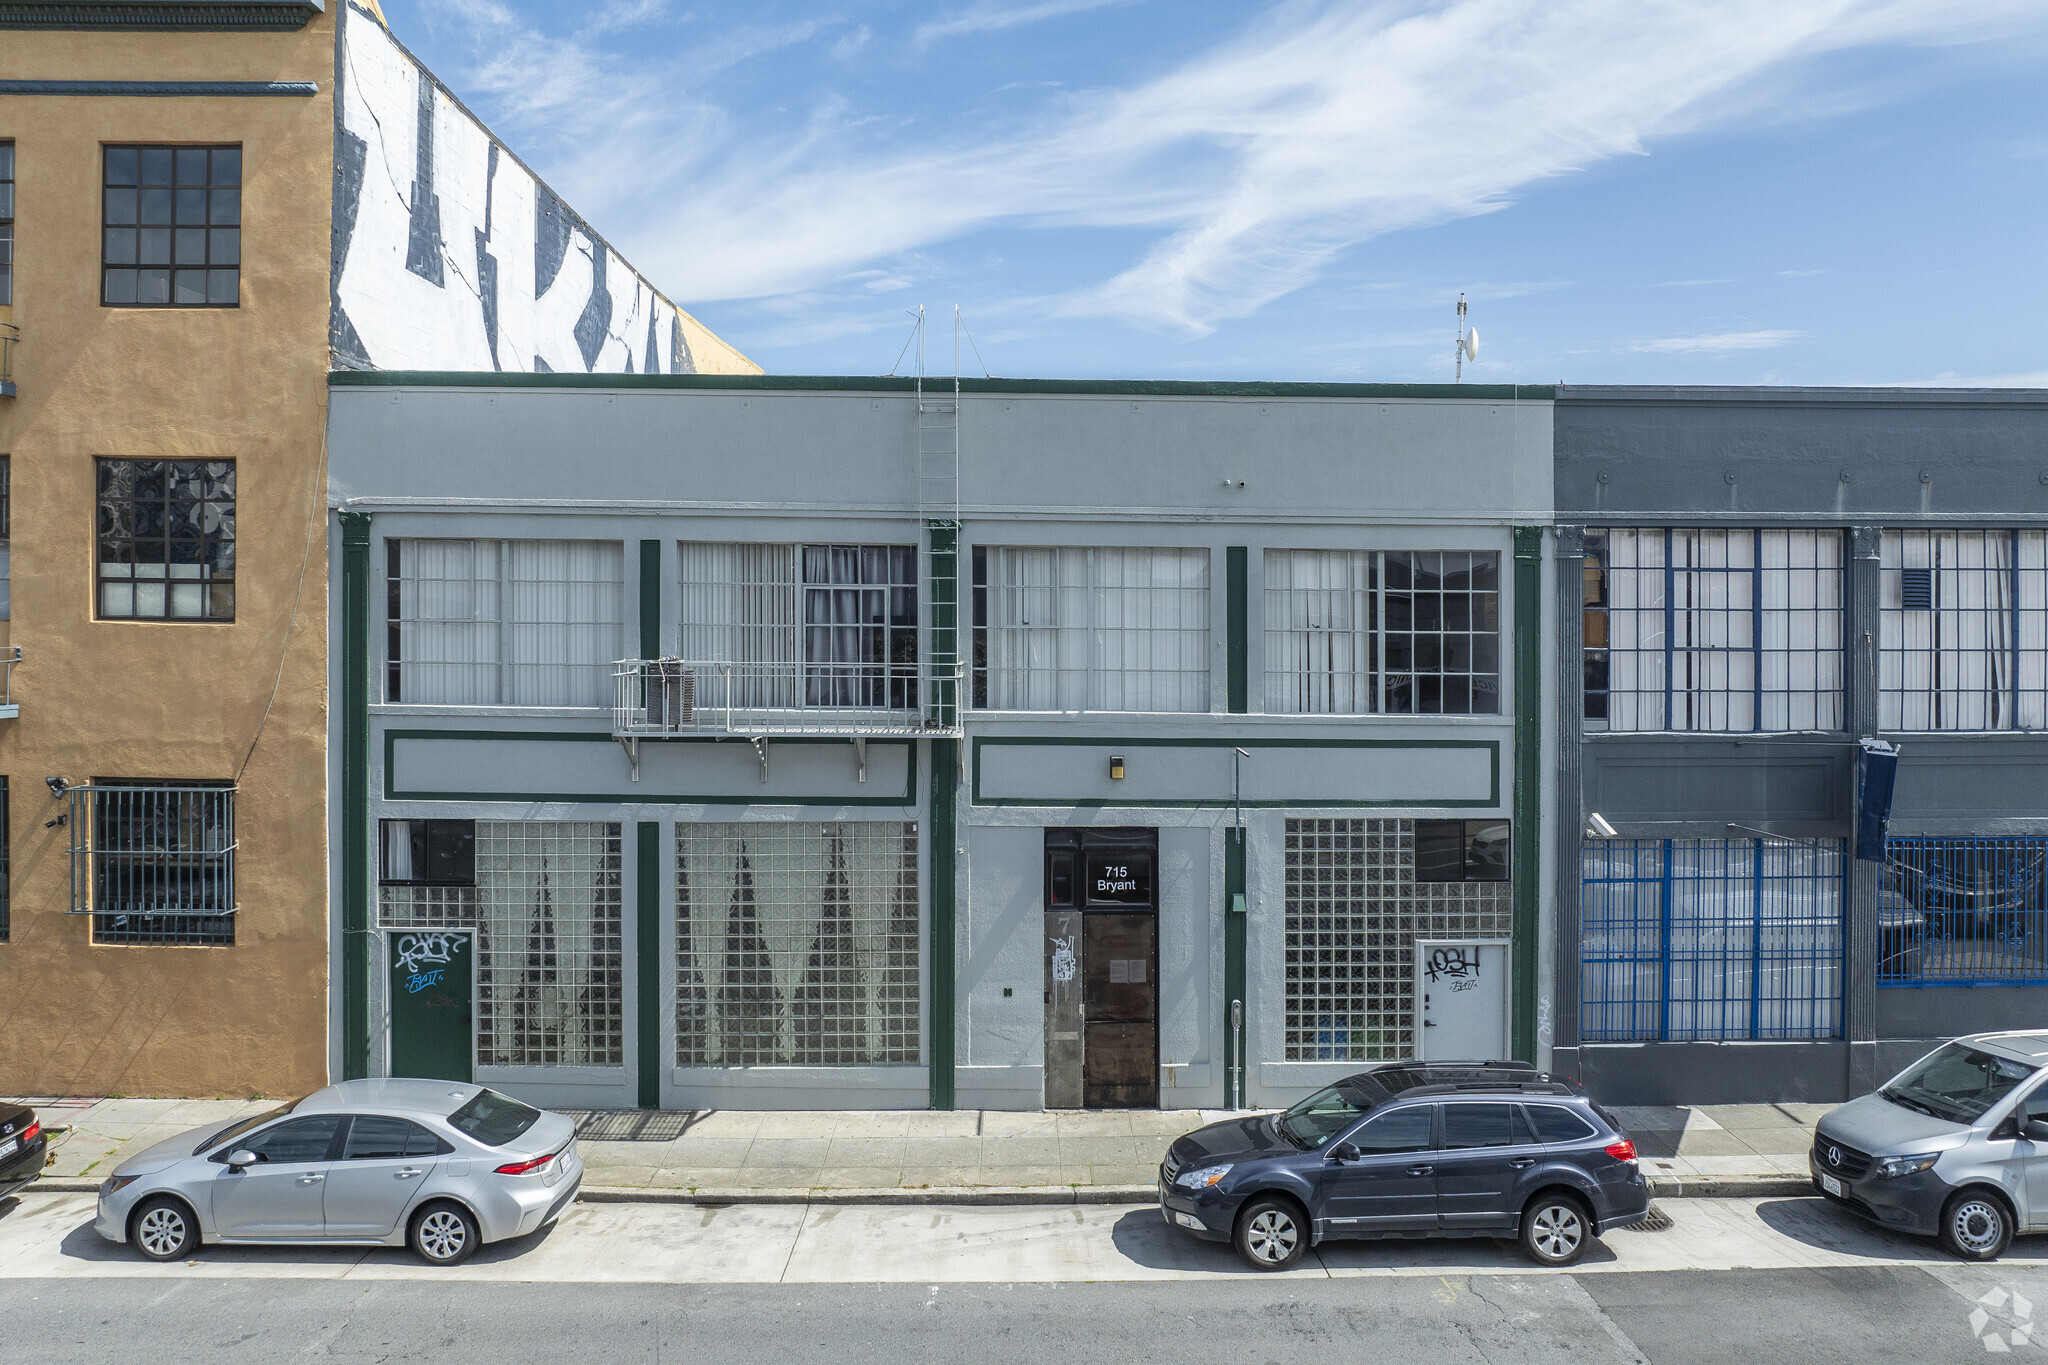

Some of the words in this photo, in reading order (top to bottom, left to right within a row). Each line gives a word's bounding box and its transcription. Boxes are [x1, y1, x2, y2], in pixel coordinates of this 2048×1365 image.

[1105, 866, 1128, 878] 715
[1097, 879, 1136, 893] Bryant
[1058, 917, 1071, 934] 7
